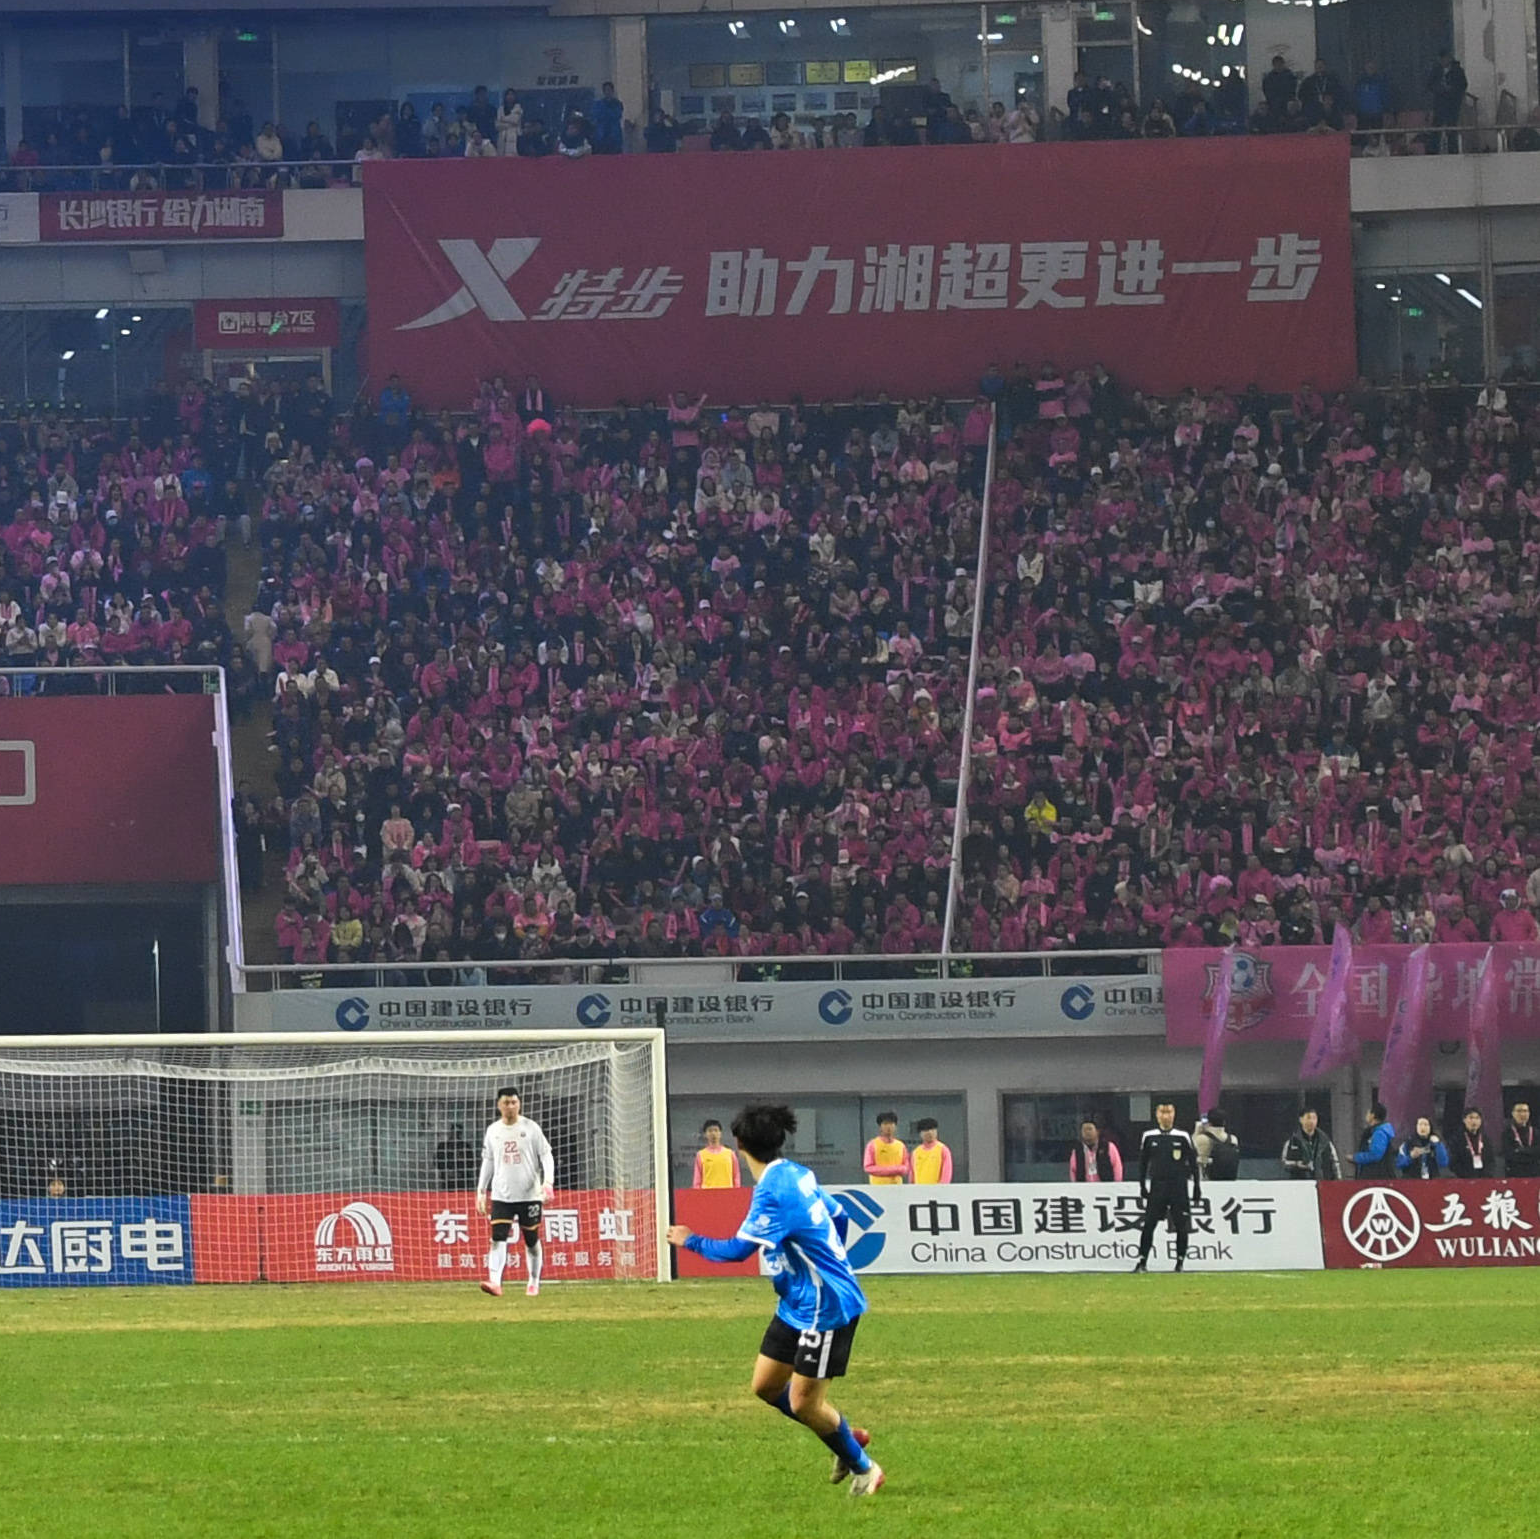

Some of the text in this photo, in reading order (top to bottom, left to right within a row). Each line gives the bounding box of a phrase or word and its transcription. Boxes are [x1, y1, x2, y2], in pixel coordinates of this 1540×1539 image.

[707, 232, 1322, 317] 助力湘超更进一步
[379, 998, 532, 1018] 中国建设银行
[862, 990, 1017, 1011] 中国建设银行
[862, 1010, 996, 1022] China Construction Bank
[504, 1141, 518, 1153] 22
[432, 1207, 636, 1245] 东雨虹
[316, 1246, 393, 1262] 东方雨虹
[911, 1241, 986, 1263] China
[997, 1239, 1157, 1261] Construction
[1435, 1236, 1540, 1258] WULIAN
